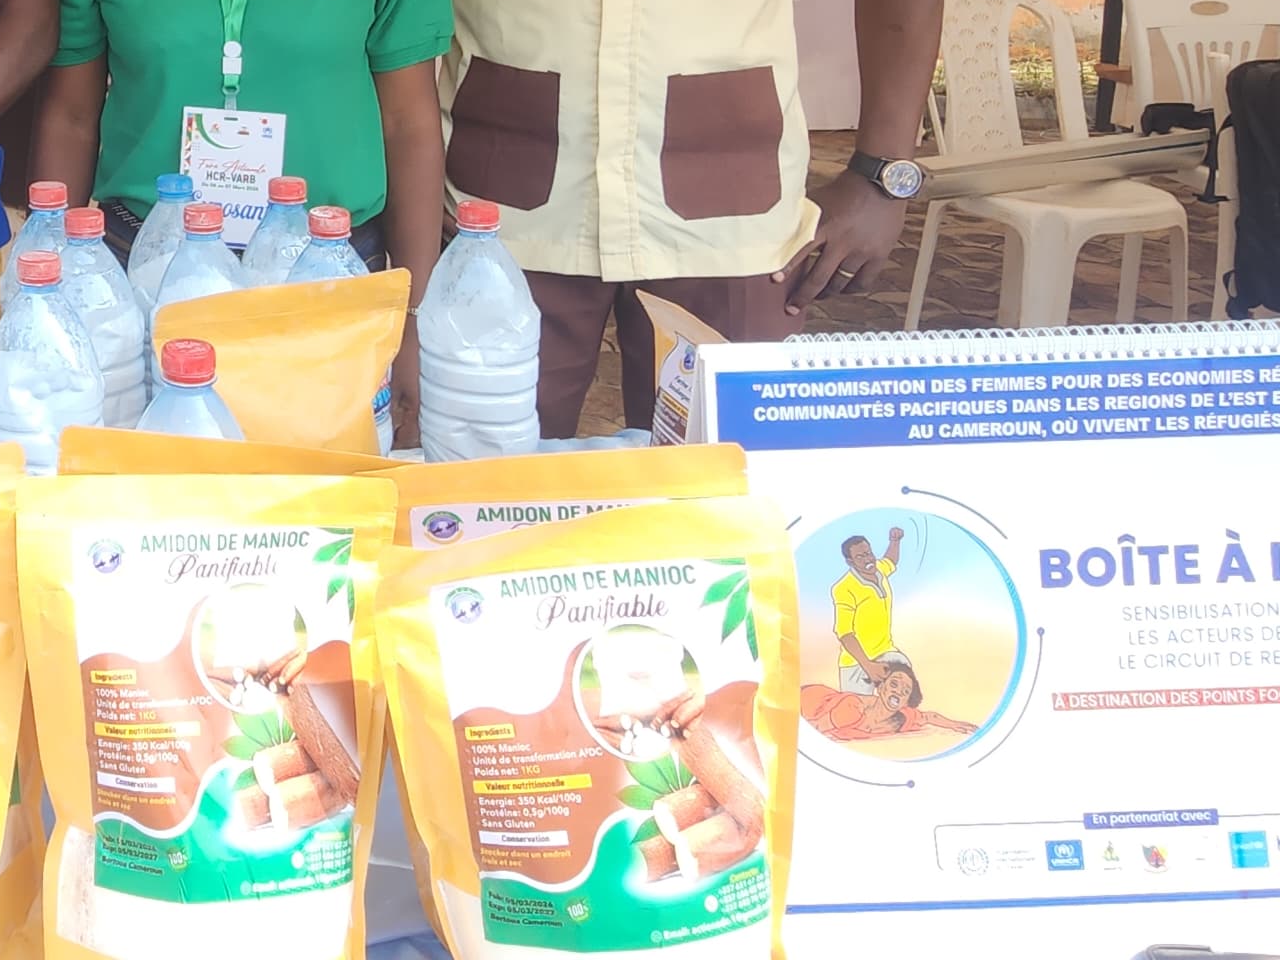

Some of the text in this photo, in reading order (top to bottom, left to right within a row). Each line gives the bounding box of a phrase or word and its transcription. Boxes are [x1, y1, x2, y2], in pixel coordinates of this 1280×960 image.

[206, 170, 256, 184] HCR-VARB
[931, 378, 967, 394] DES
[972, 376, 1047, 393] FEMMES
[1052, 374, 1102, 390] POUR
[1107, 372, 1143, 388] DES
[1148, 369, 1255, 387] ECONOMIES
[753, 391, 1268, 422] COMMUNAUTÉS PACIFIQUES DANS LES REGIONS DE L'EST
[908, 410, 1280, 440] AU CAMEROUN, OÙ VIVENT LES RÉFUGIÉS
[476, 505, 552, 523] AMIDON
[140, 530, 309, 553] AMIDON DE MANIOC
[1039, 528, 1256, 588] BOÎTE À
[500, 564, 697, 599] AMIDON DE MANIOC
[535, 593, 669, 631] Panifiable
[1121, 602, 1280, 622] SENSIBILISATION
[1128, 630, 1159, 645] LES
[1167, 626, 1254, 644] ACTEURS
[1118, 654, 1137, 670] LE
[1144, 652, 1221, 668] CIRCUIT
[1230, 651, 1253, 666] DE
[1069, 691, 1167, 708] DESTINATION
[1171, 690, 1200, 706] DES
[1203, 689, 1256, 705] POINTS
[1260, 688, 1280, 702] FO
[472, 743, 531, 754] 100% Manioc
[472, 756, 497, 765] Unité
[499, 755, 511, 764] de
[512, 750, 576, 763] transformation
[474, 767, 499, 776] Poids
[521, 765, 540, 775] 1KG
[485, 783, 510, 791] Valeur
[517, 796, 535, 805] 350
[482, 818, 535, 828] Sans Gluten
[1092, 811, 1211, 827] En partenariat avec
